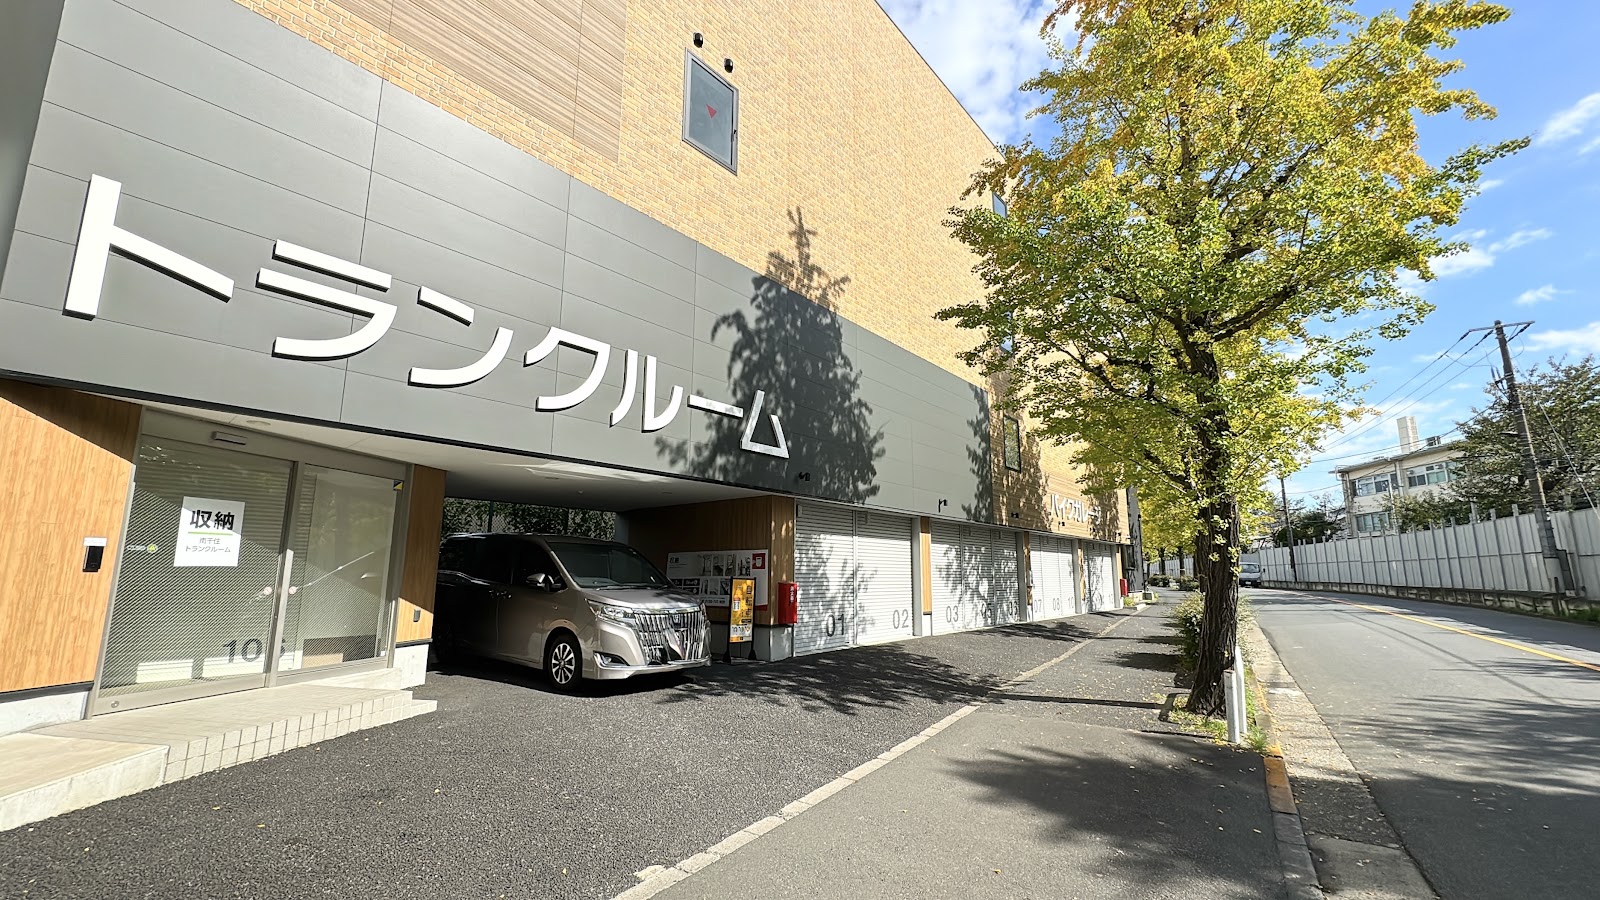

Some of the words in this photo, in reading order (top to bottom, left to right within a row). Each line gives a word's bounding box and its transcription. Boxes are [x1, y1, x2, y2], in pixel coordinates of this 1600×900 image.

[63, 173, 790, 459] トランクルーム
[190, 510, 235, 530] 収納
[185, 545, 231, 553] トランクルーム
[892, 609, 909, 630] 02
[946, 605, 958, 623] 03
[826, 613, 844, 637] 01
